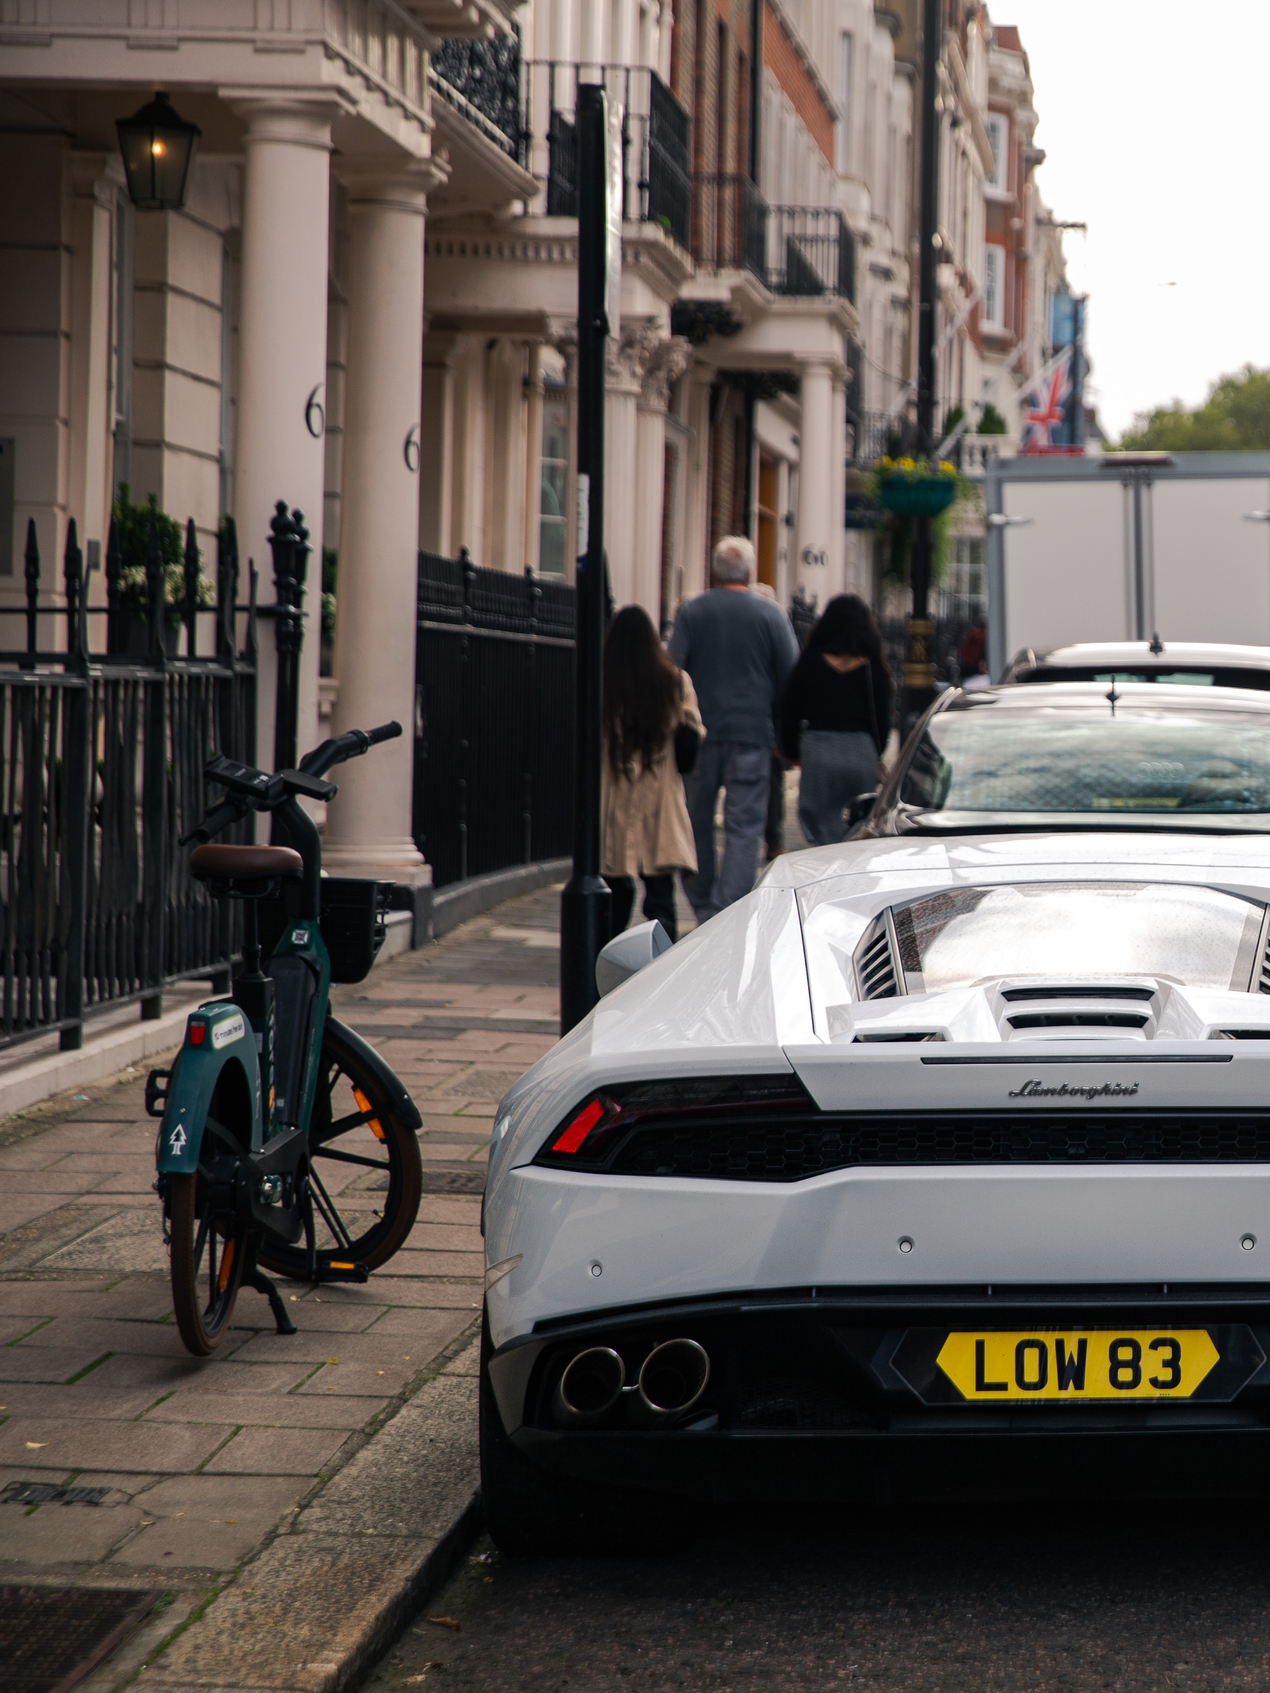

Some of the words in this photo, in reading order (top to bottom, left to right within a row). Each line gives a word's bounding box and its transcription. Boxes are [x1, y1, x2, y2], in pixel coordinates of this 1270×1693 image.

[1008, 1077, 1140, 1100] Lamborghini
[975, 1337, 1088, 1392] LOW
[1108, 1336, 1181, 1391] 83
